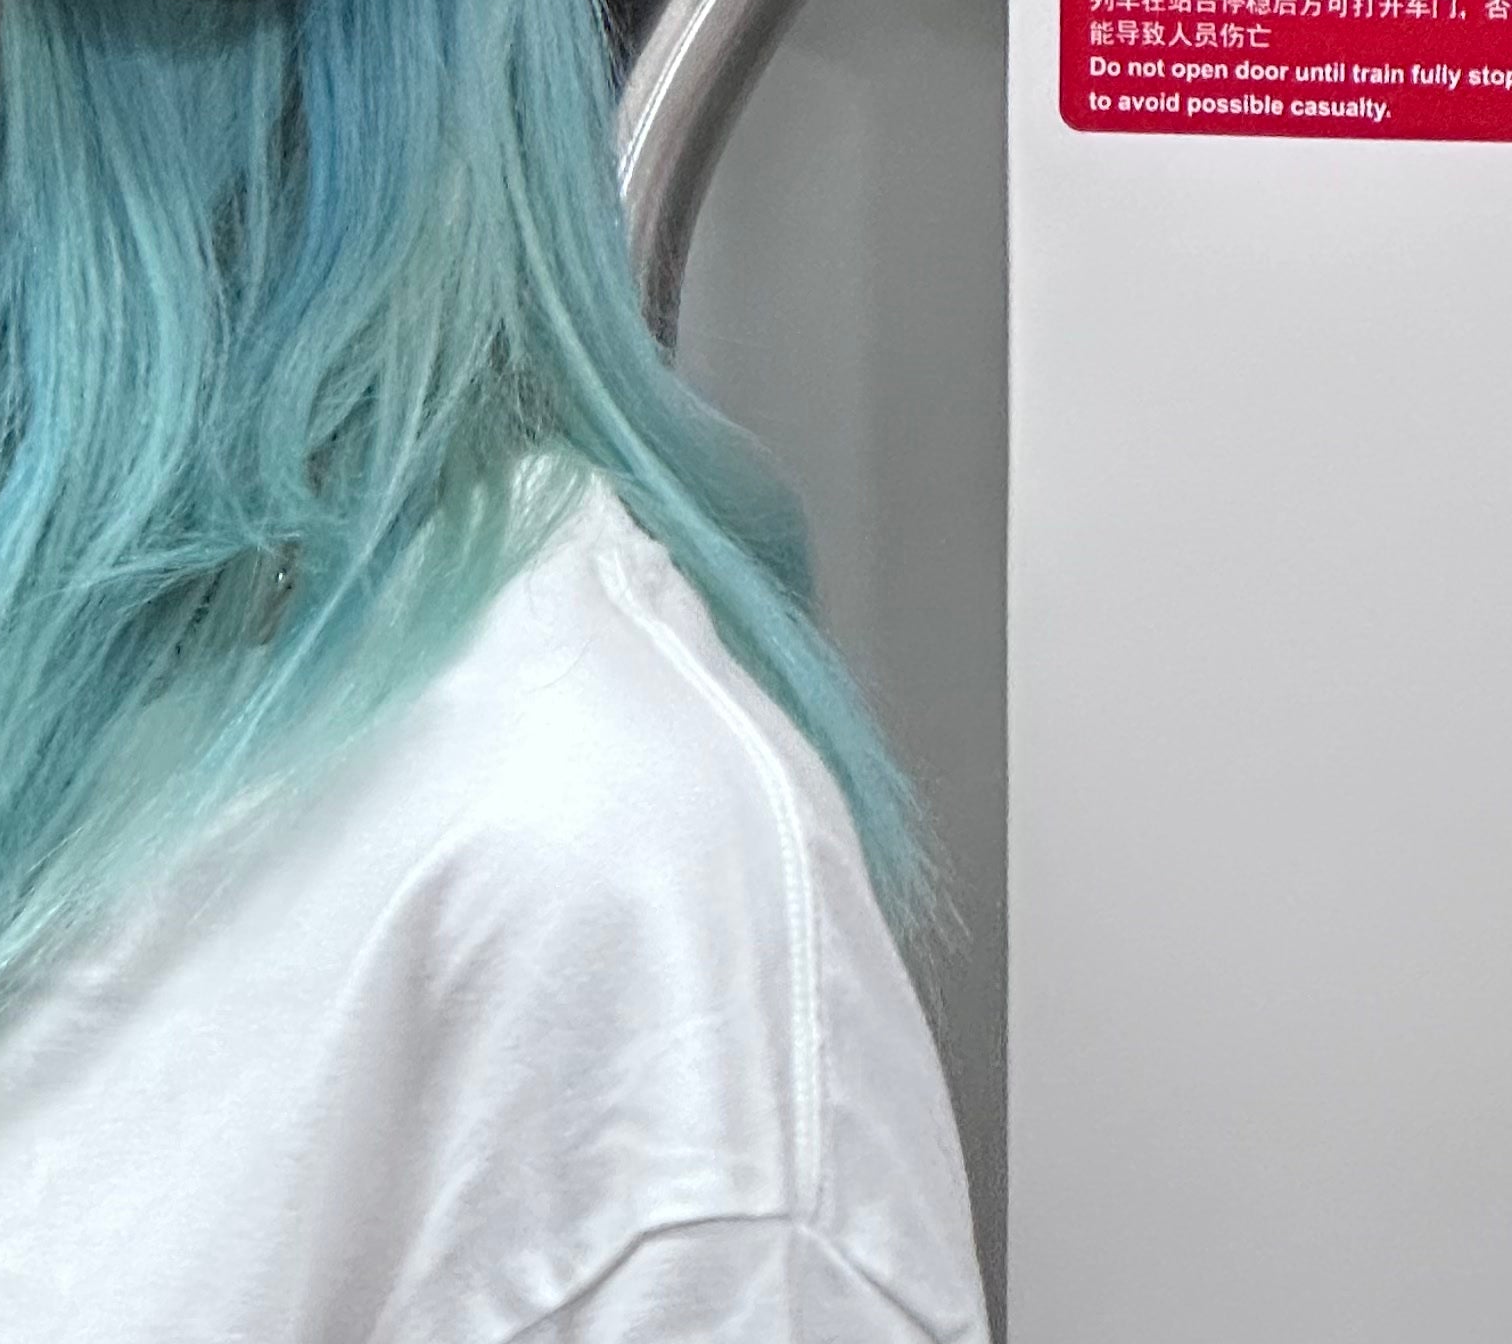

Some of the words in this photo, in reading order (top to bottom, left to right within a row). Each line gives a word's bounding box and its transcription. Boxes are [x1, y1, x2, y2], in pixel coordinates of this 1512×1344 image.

[1090, 20, 1272, 48] 能导致人员伤亡
[1090, 56, 1121, 77] Do
[1128, 59, 1165, 78] not
[1171, 63, 1228, 83] open
[1235, 60, 1289, 81] door
[1295, 62, 1346, 83] until
[1352, 63, 1405, 84] train
[1412, 64, 1462, 91] fully
[1089, 91, 1111, 111] to
[1118, 92, 1180, 113] avoid
[1187, 95, 1284, 117] possible
[1291, 97, 1391, 122] casualty.
